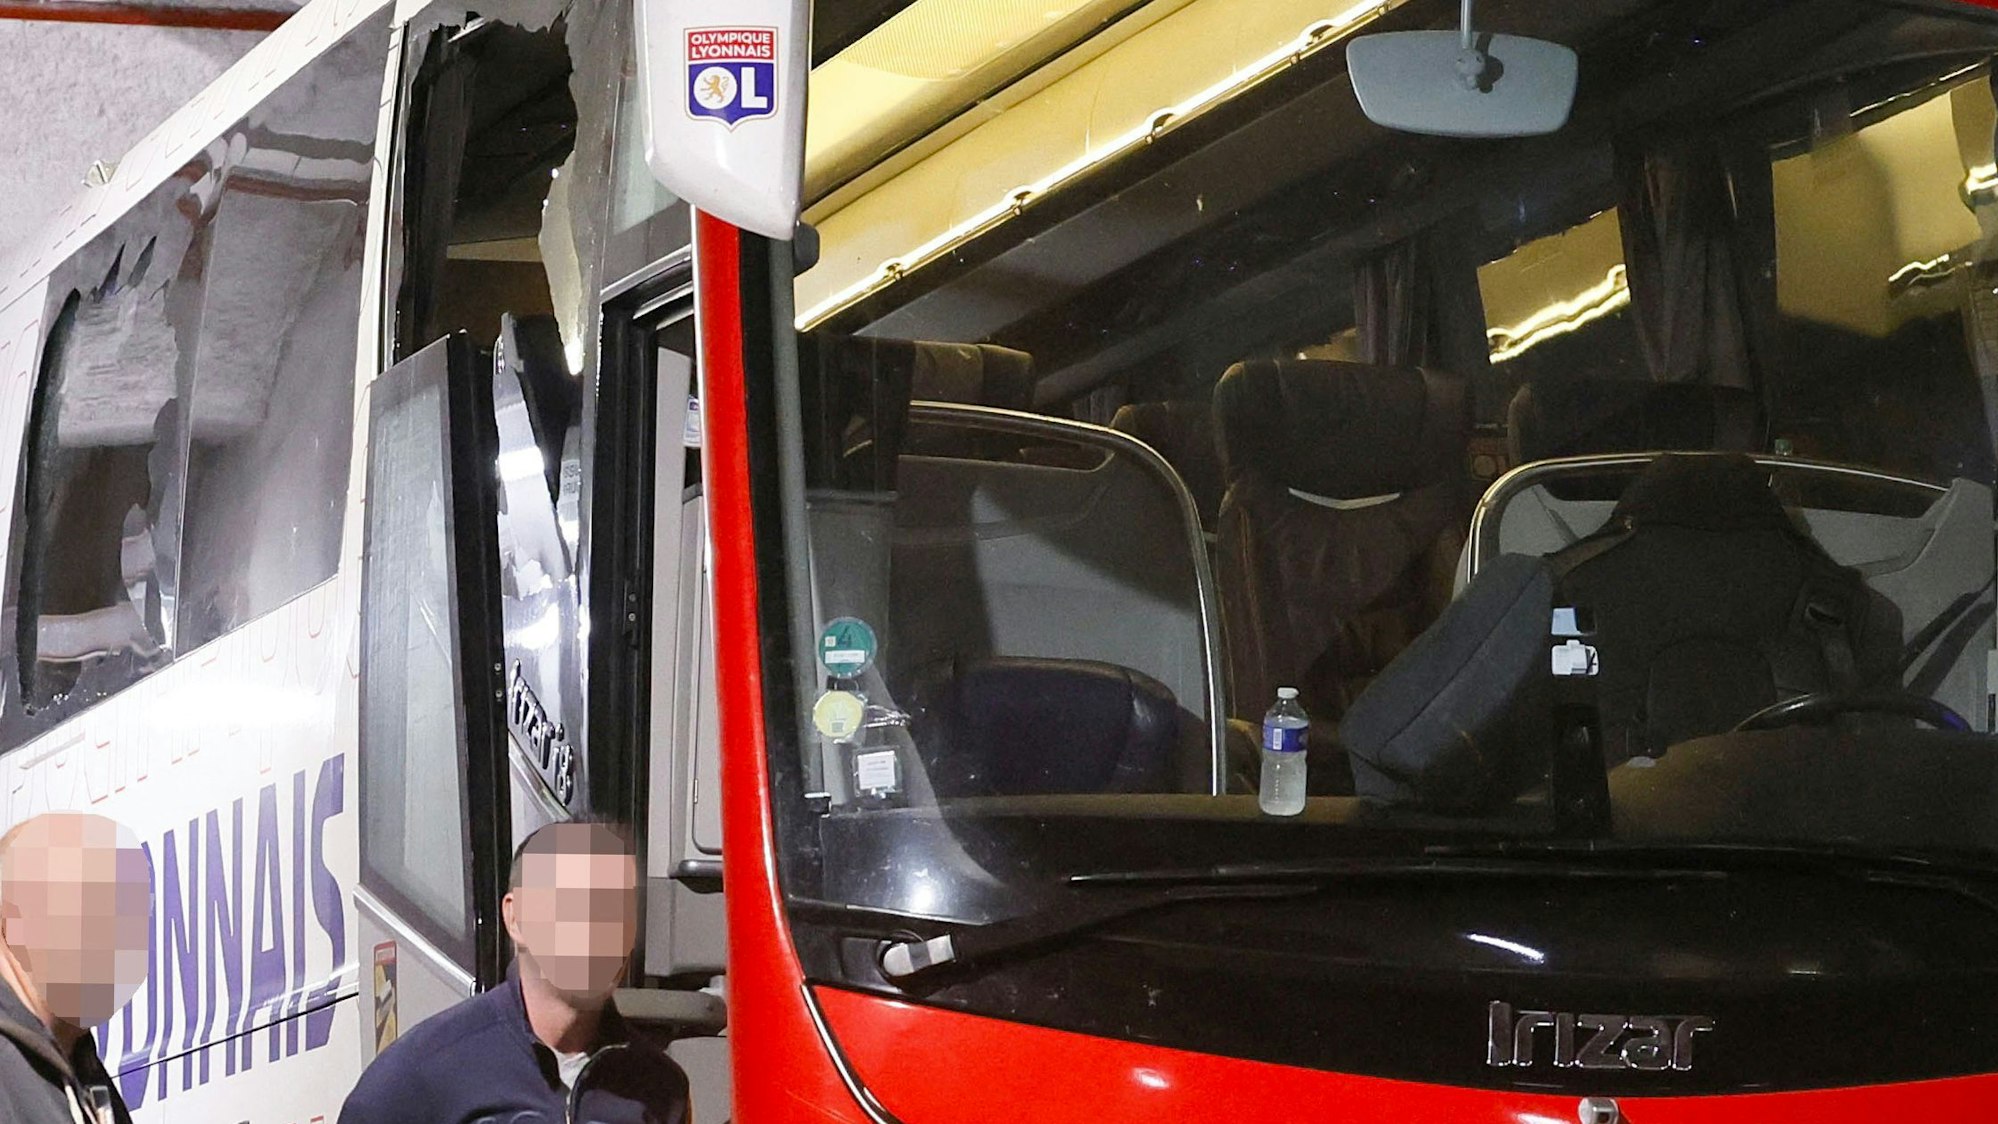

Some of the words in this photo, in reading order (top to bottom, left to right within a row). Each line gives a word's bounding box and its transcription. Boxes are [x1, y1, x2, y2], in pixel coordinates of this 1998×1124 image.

[691, 32, 771, 45] OLYMPIQUE
[691, 44, 771, 59] LYONNAIS
[693, 66, 768, 110] OL
[1486, 1000, 1716, 1070] Irizar
